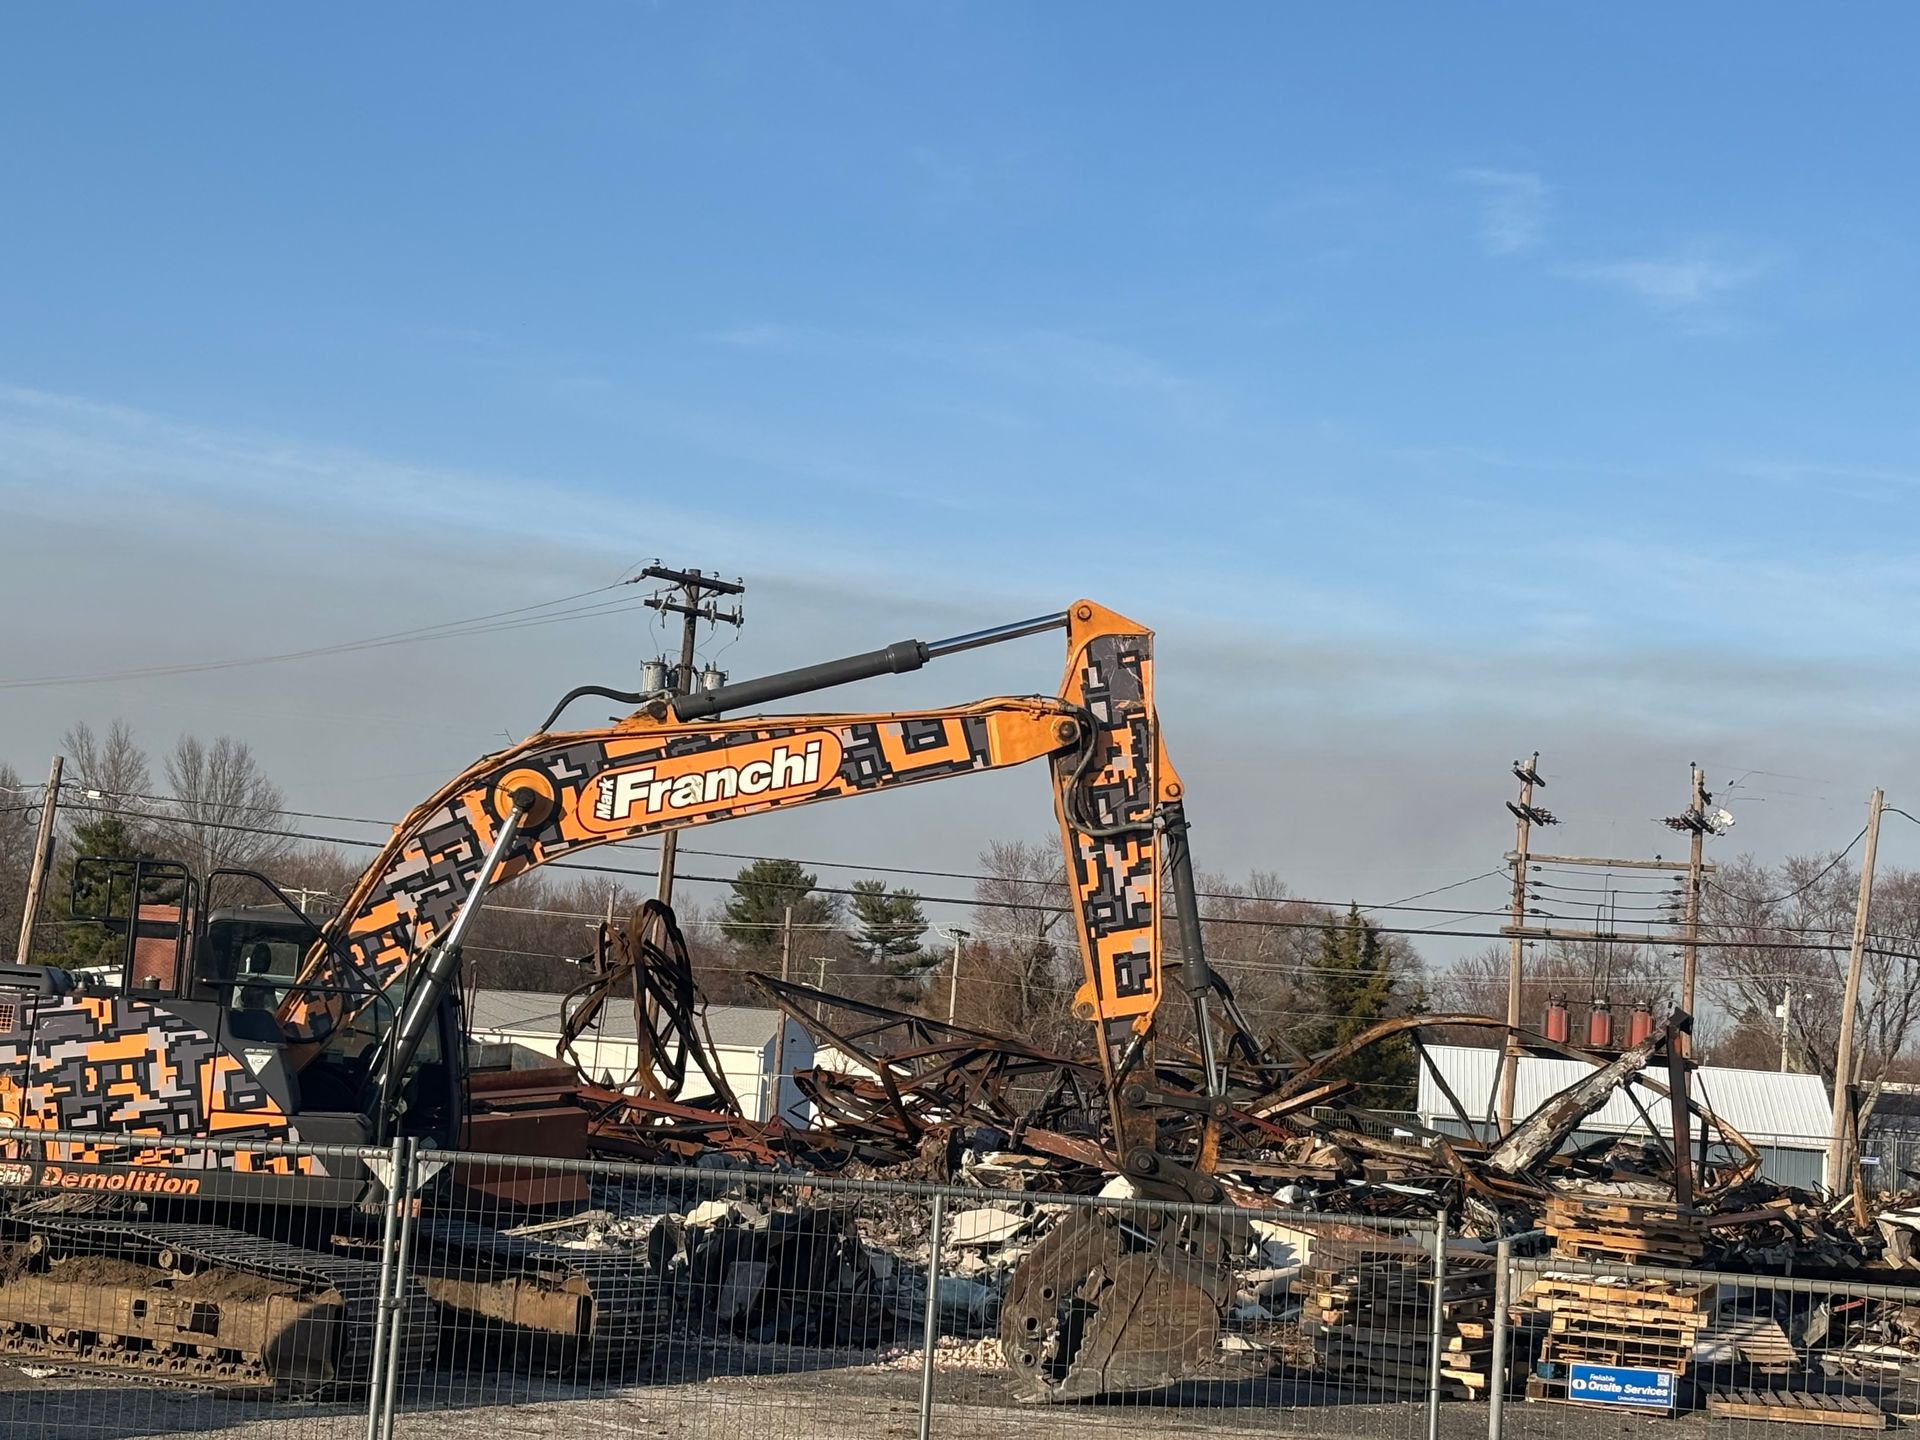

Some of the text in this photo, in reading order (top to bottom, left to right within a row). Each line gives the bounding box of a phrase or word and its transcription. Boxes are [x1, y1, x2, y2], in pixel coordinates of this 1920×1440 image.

[595, 741, 821, 819] Mark Franchi
[40, 1166, 200, 1194] Demolition
[1588, 1381, 1668, 1396] Onsite Services
